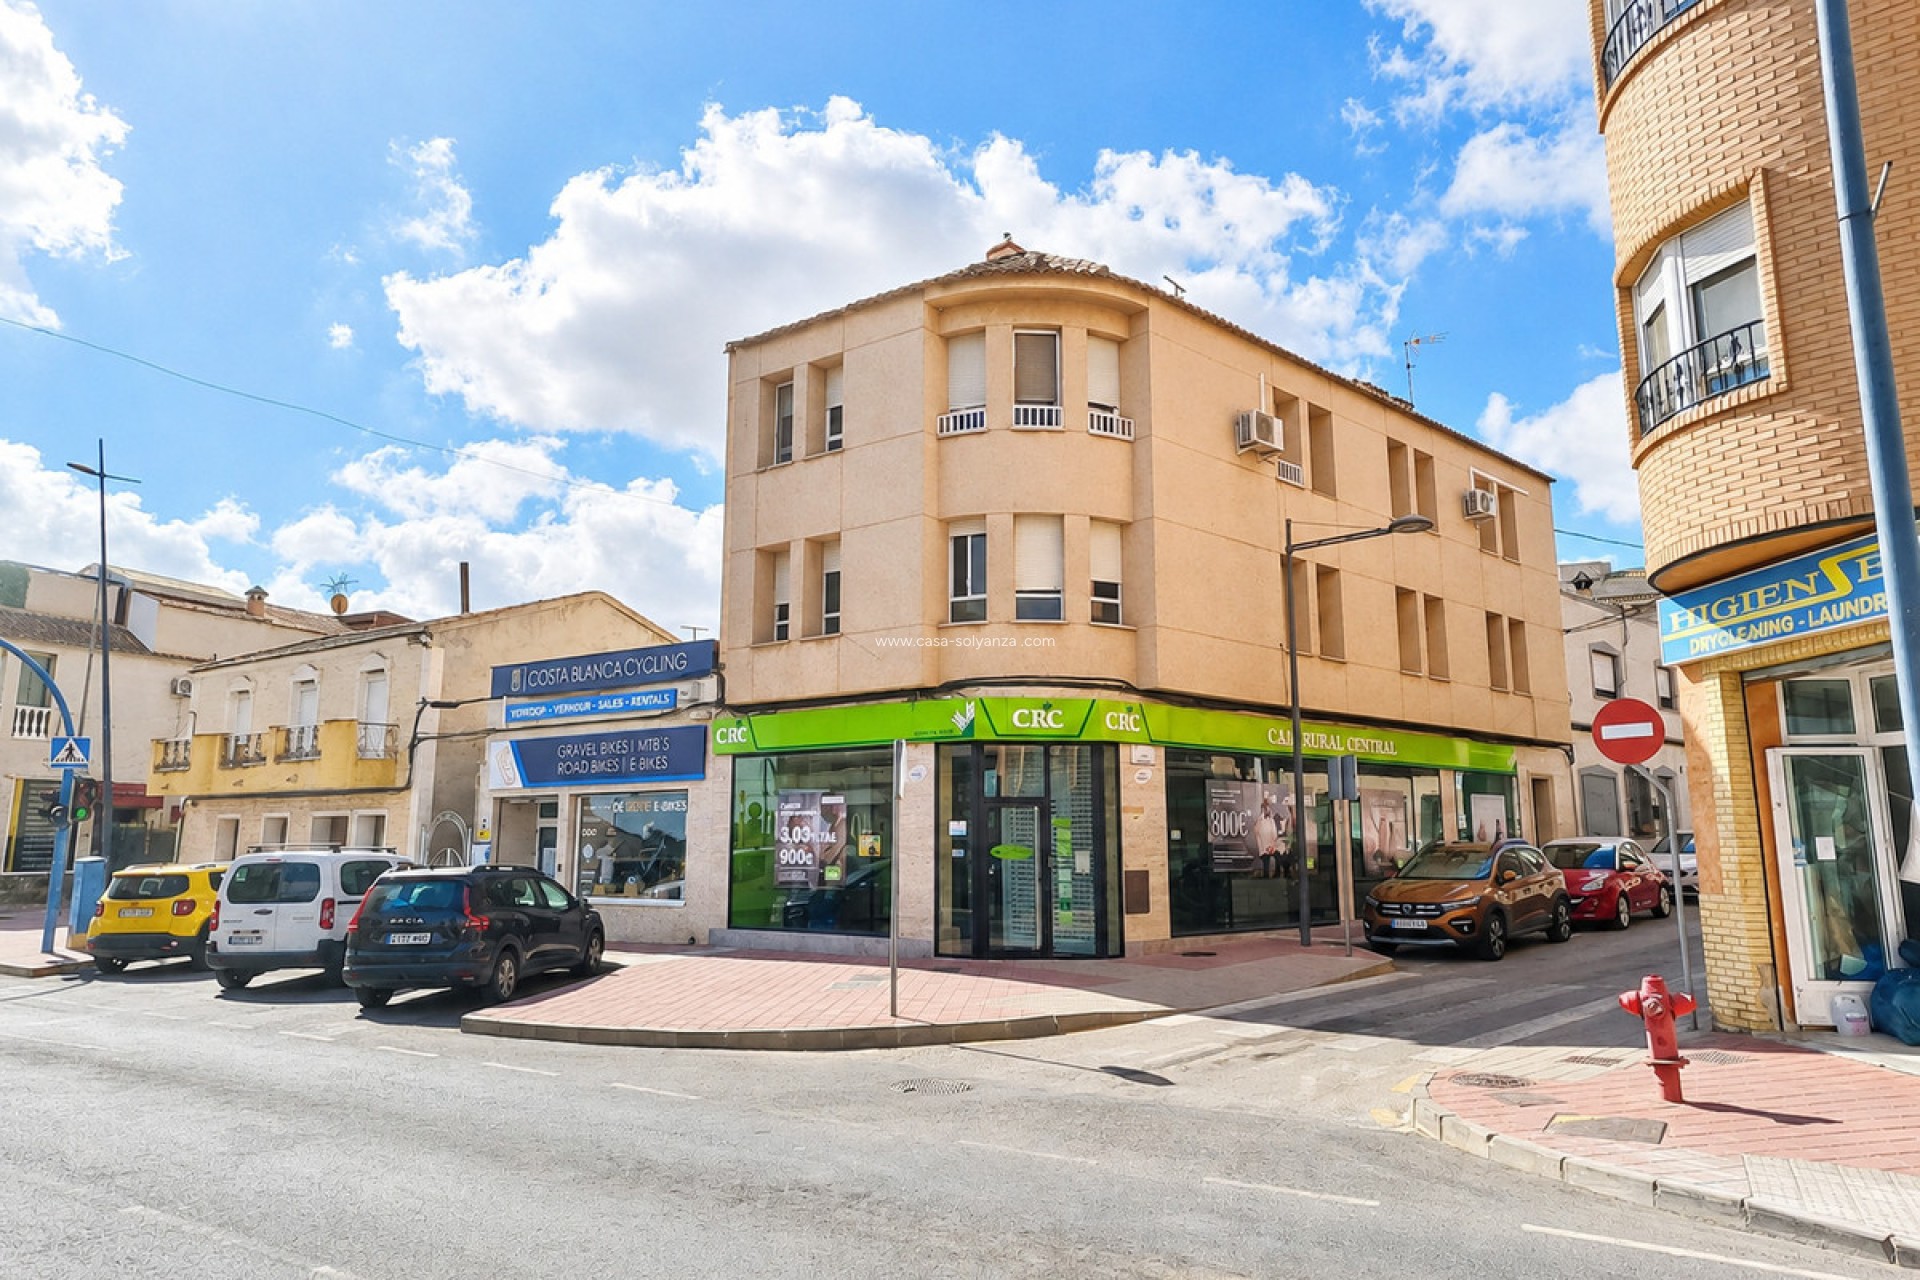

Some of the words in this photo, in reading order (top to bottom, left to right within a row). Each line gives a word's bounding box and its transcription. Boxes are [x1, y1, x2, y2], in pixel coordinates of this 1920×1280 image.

[1808, 593, 1888, 628] LAUNDR
[527, 667, 567, 687] COSTA
[570, 662, 622, 683] BLANCA
[624, 653, 687, 675] CYCLING
[598, 698, 624, 709] SALES
[630, 694, 669, 706] RENTALS
[1012, 708, 1064, 729] CRC
[1105, 712, 1141, 732] CRC
[716, 726, 748, 745] CRC
[1302, 732, 1344, 751] RURAL
[1347, 737, 1397, 755] CENTRAL
[557, 742, 597, 758] GRAVEL
[601, 740, 628, 755] BIKES
[557, 760, 589, 775] ROAD
[590, 758, 619, 773] BIKES
[639, 755, 668, 770] BIKES
